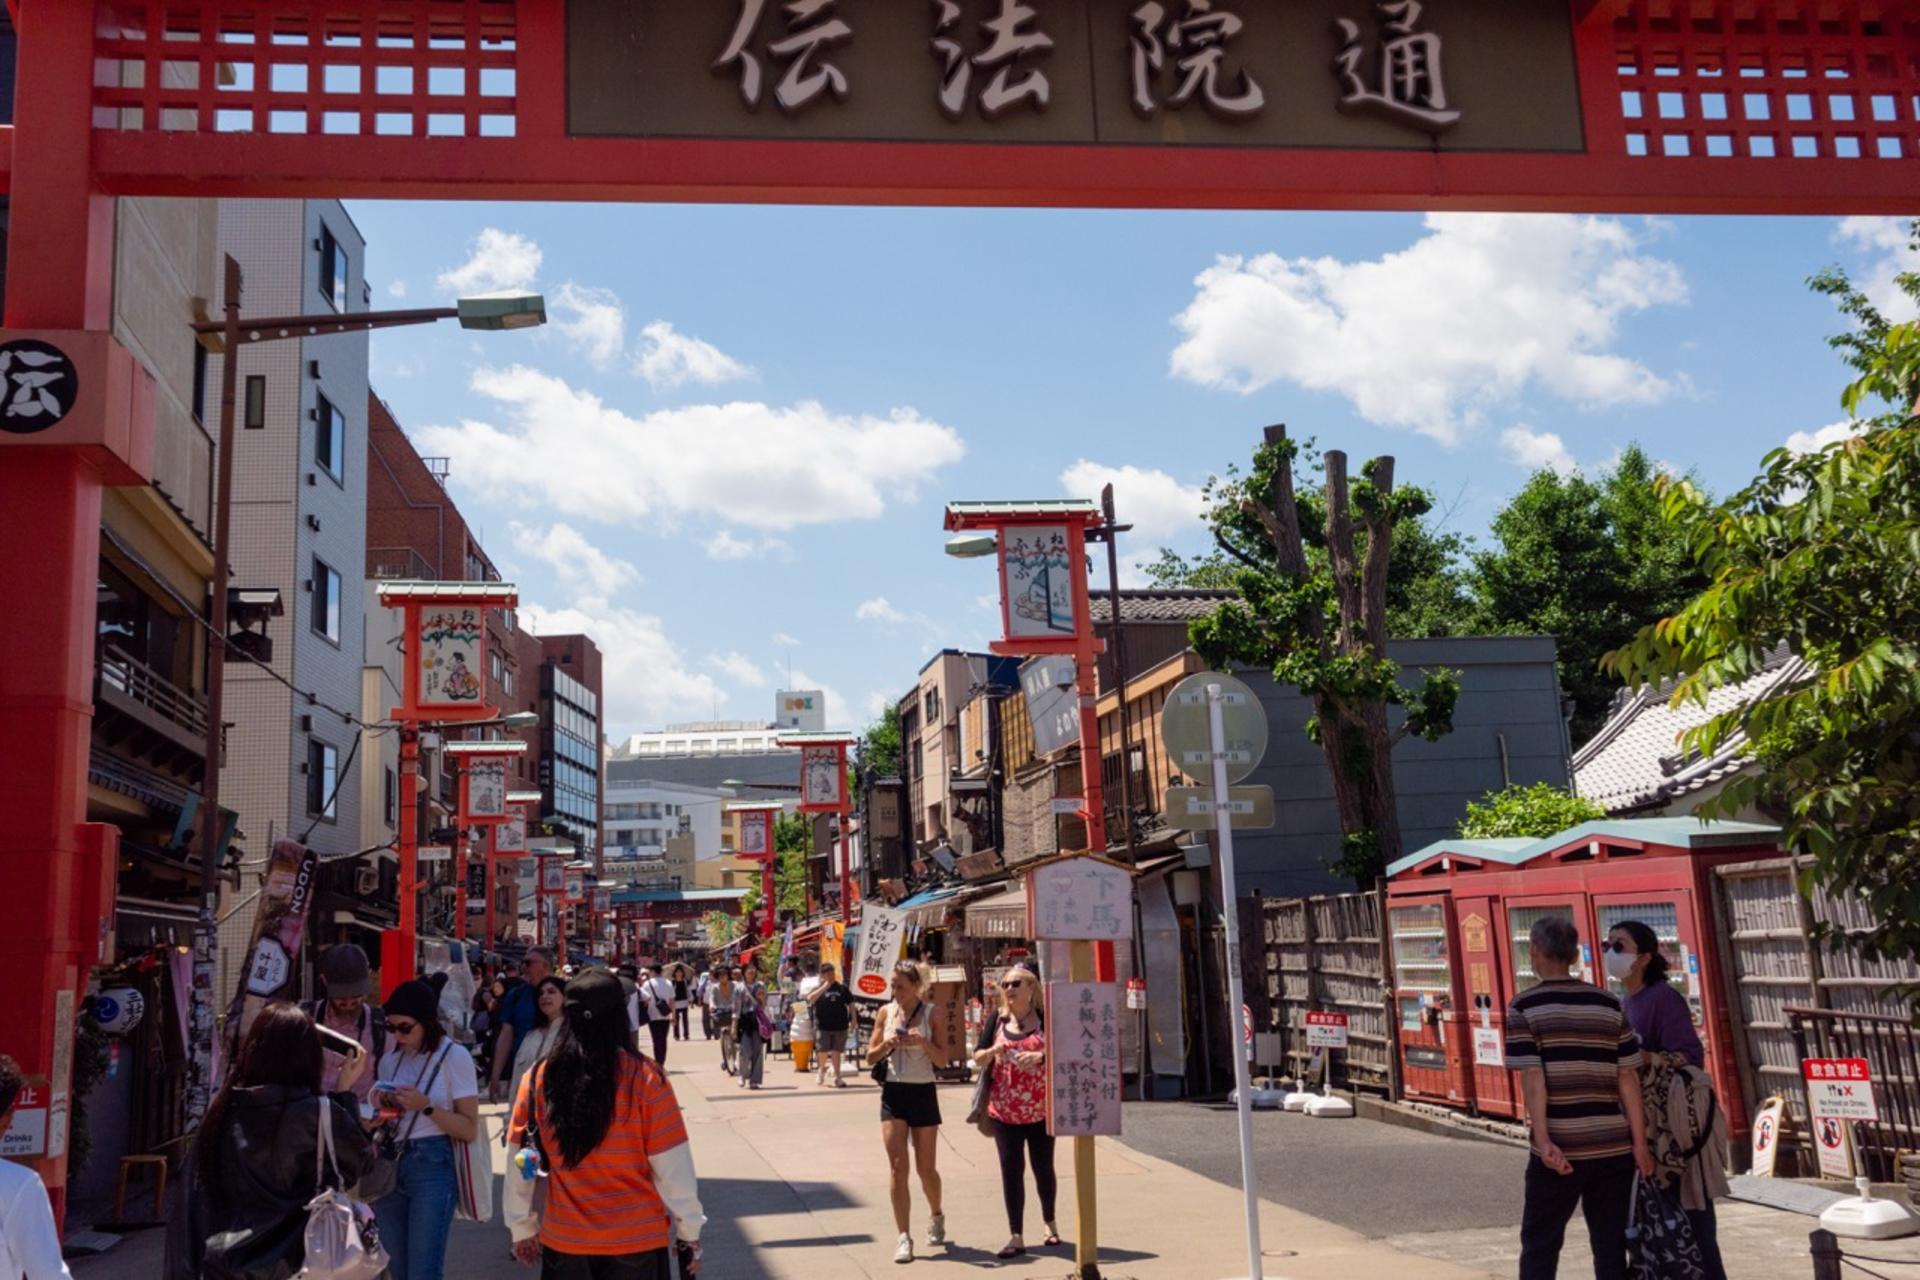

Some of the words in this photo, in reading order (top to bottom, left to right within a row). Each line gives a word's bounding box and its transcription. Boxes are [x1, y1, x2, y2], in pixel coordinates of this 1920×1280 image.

[713, 0, 1462, 126] 伝法院通
[290, 860, 314, 914] UDON
[1087, 868, 1121, 935] 下馬
[1810, 1063, 1864, 1078] 飲食禁止
